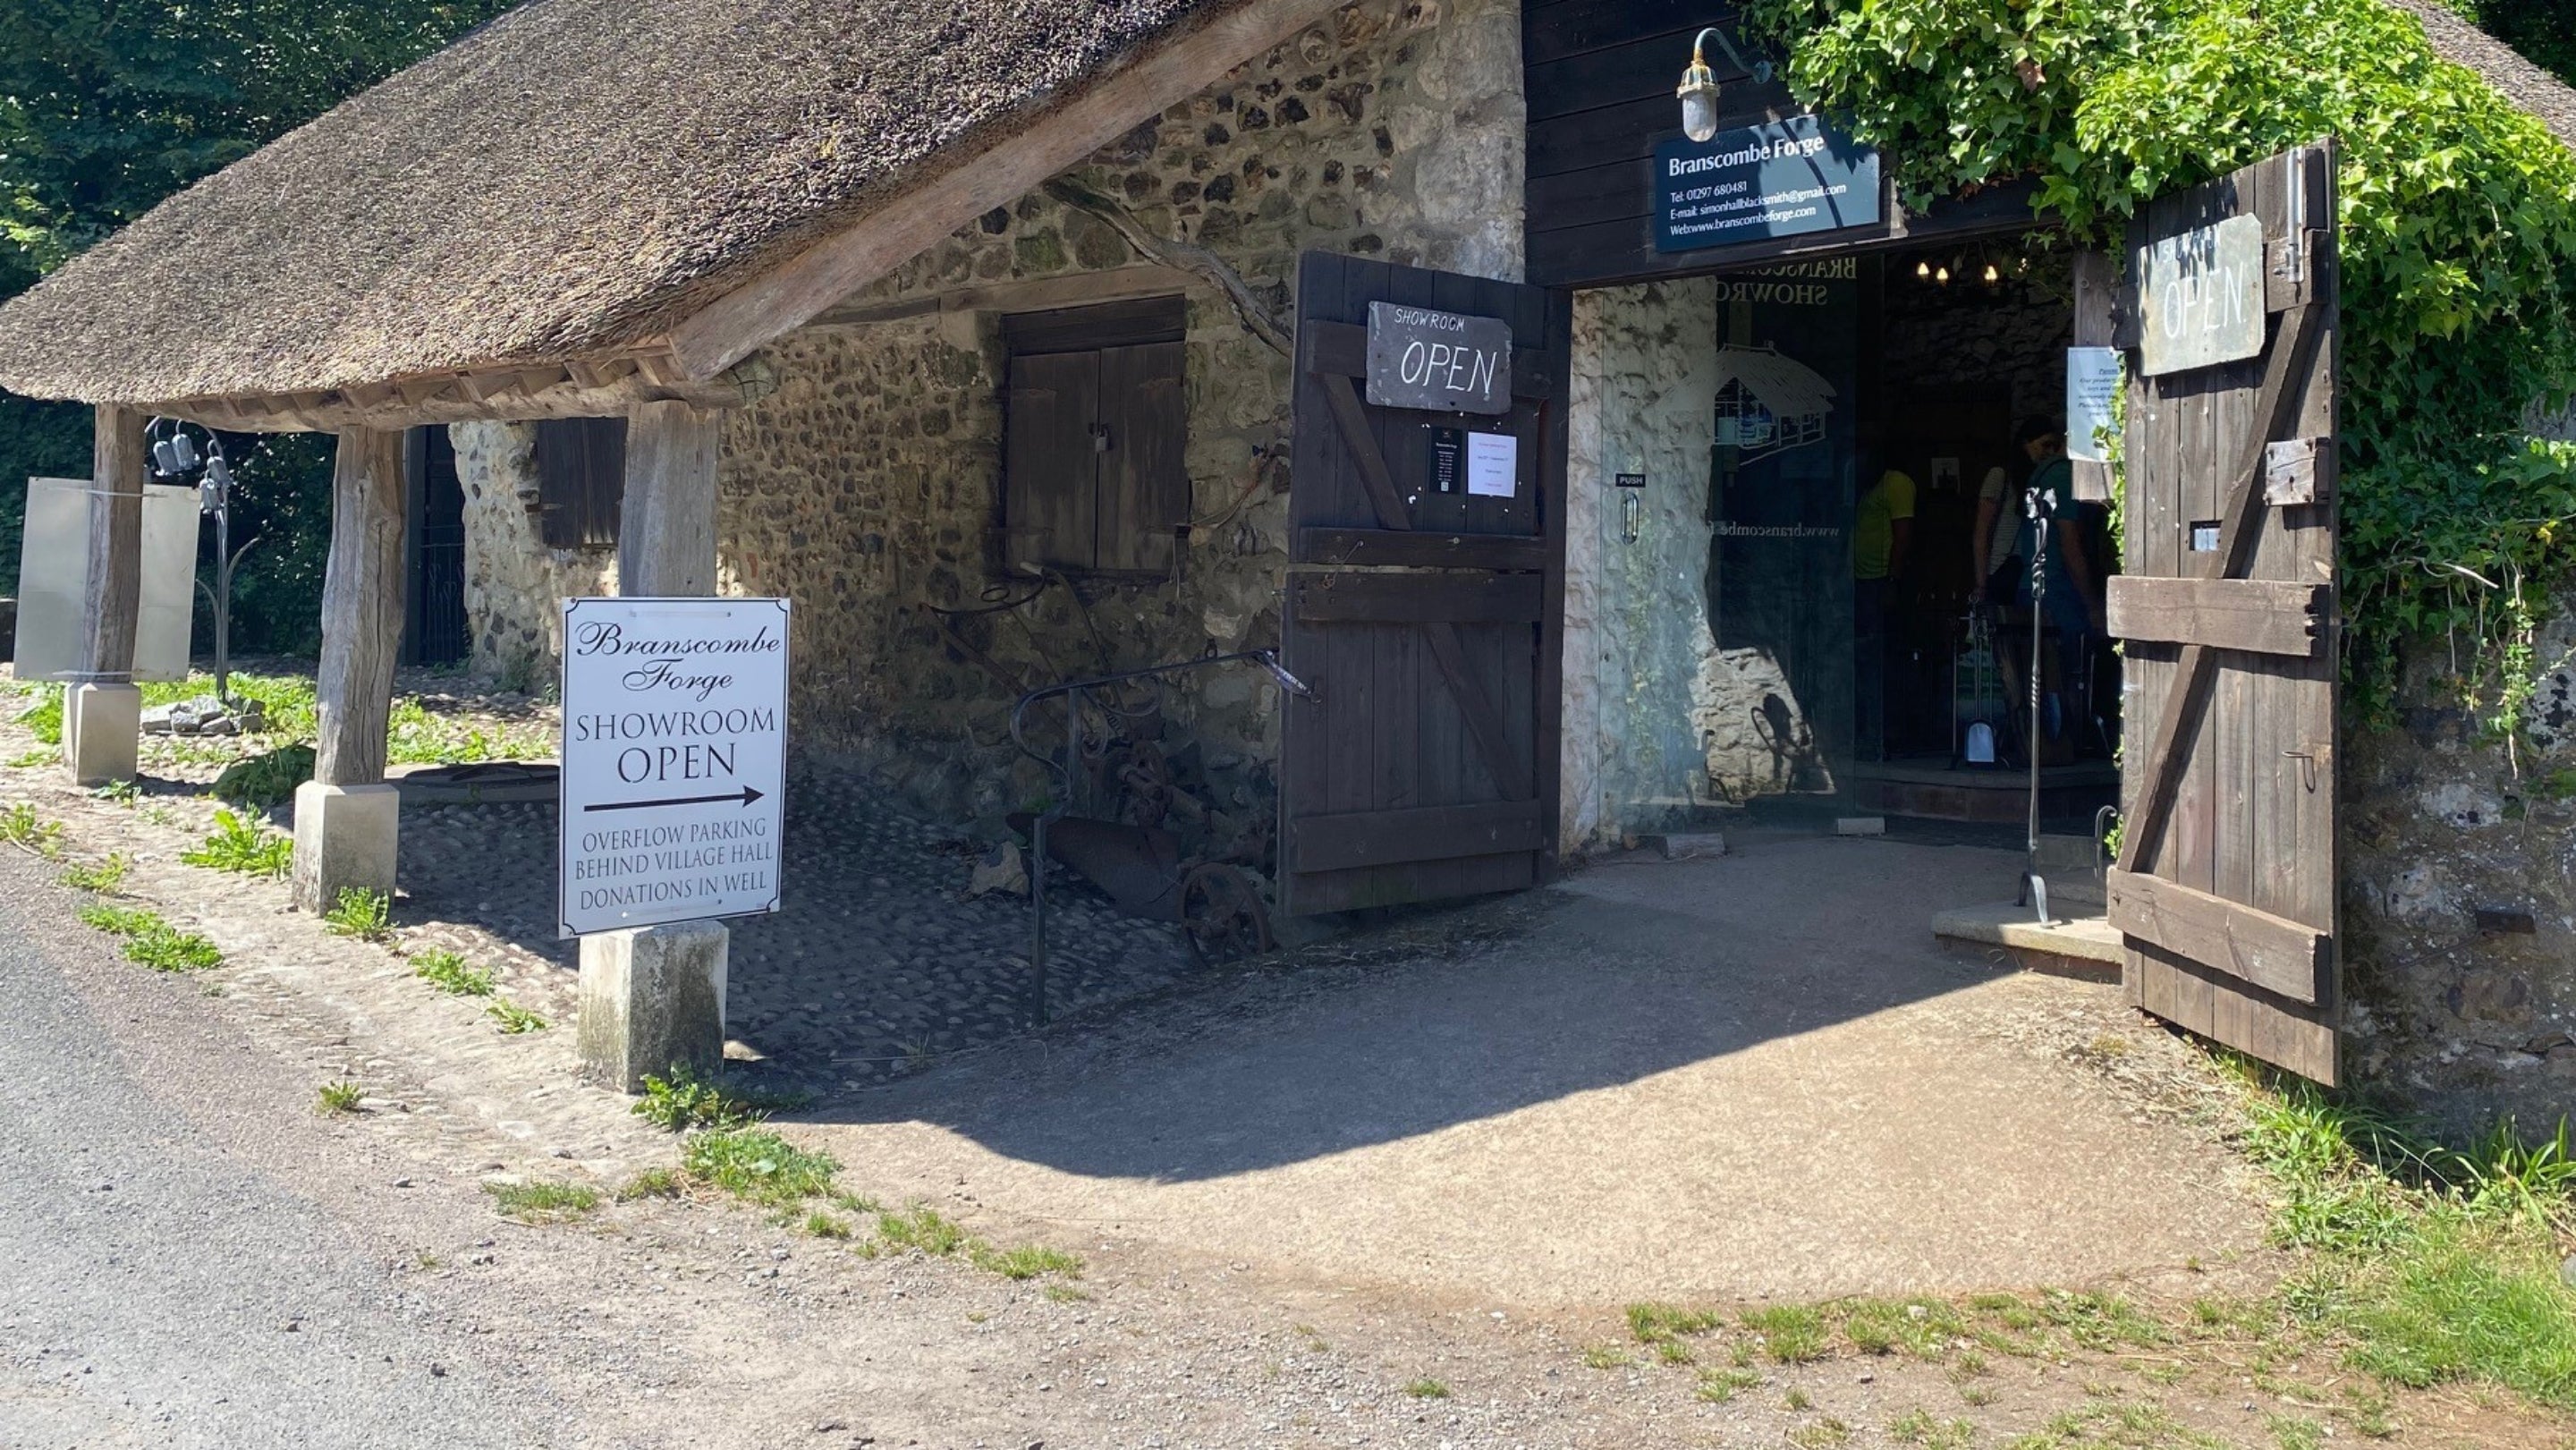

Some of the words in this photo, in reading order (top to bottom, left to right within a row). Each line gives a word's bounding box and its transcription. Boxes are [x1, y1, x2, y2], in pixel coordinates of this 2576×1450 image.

[1669, 142, 1771, 176] Branscombe
[1774, 135, 1826, 158] Forge
[1686, 186, 1712, 200] 01297
[1714, 181, 1748, 196] 680481
[1699, 183, 1847, 216] simonhallblacksmith@gmail.com
[1401, 341, 1497, 394] OPEN
[1619, 476, 1644, 485] PUSH
[575, 621, 781, 657] Branscombe
[623, 657, 733, 703] Forge
[575, 708, 775, 742] SHOWROOM
[617, 742, 735, 784] OPEN
[582, 825, 684, 852] OVERFLOW
[690, 818, 767, 843] PARKING
[575, 854, 649, 881] BEHIND
[655, 845, 725, 871] VILLAGE
[731, 841, 773, 864] HALL
[580, 878, 692, 911] DONATIONS
[699, 876, 718, 895] IN
[724, 871, 767, 892] WELL
